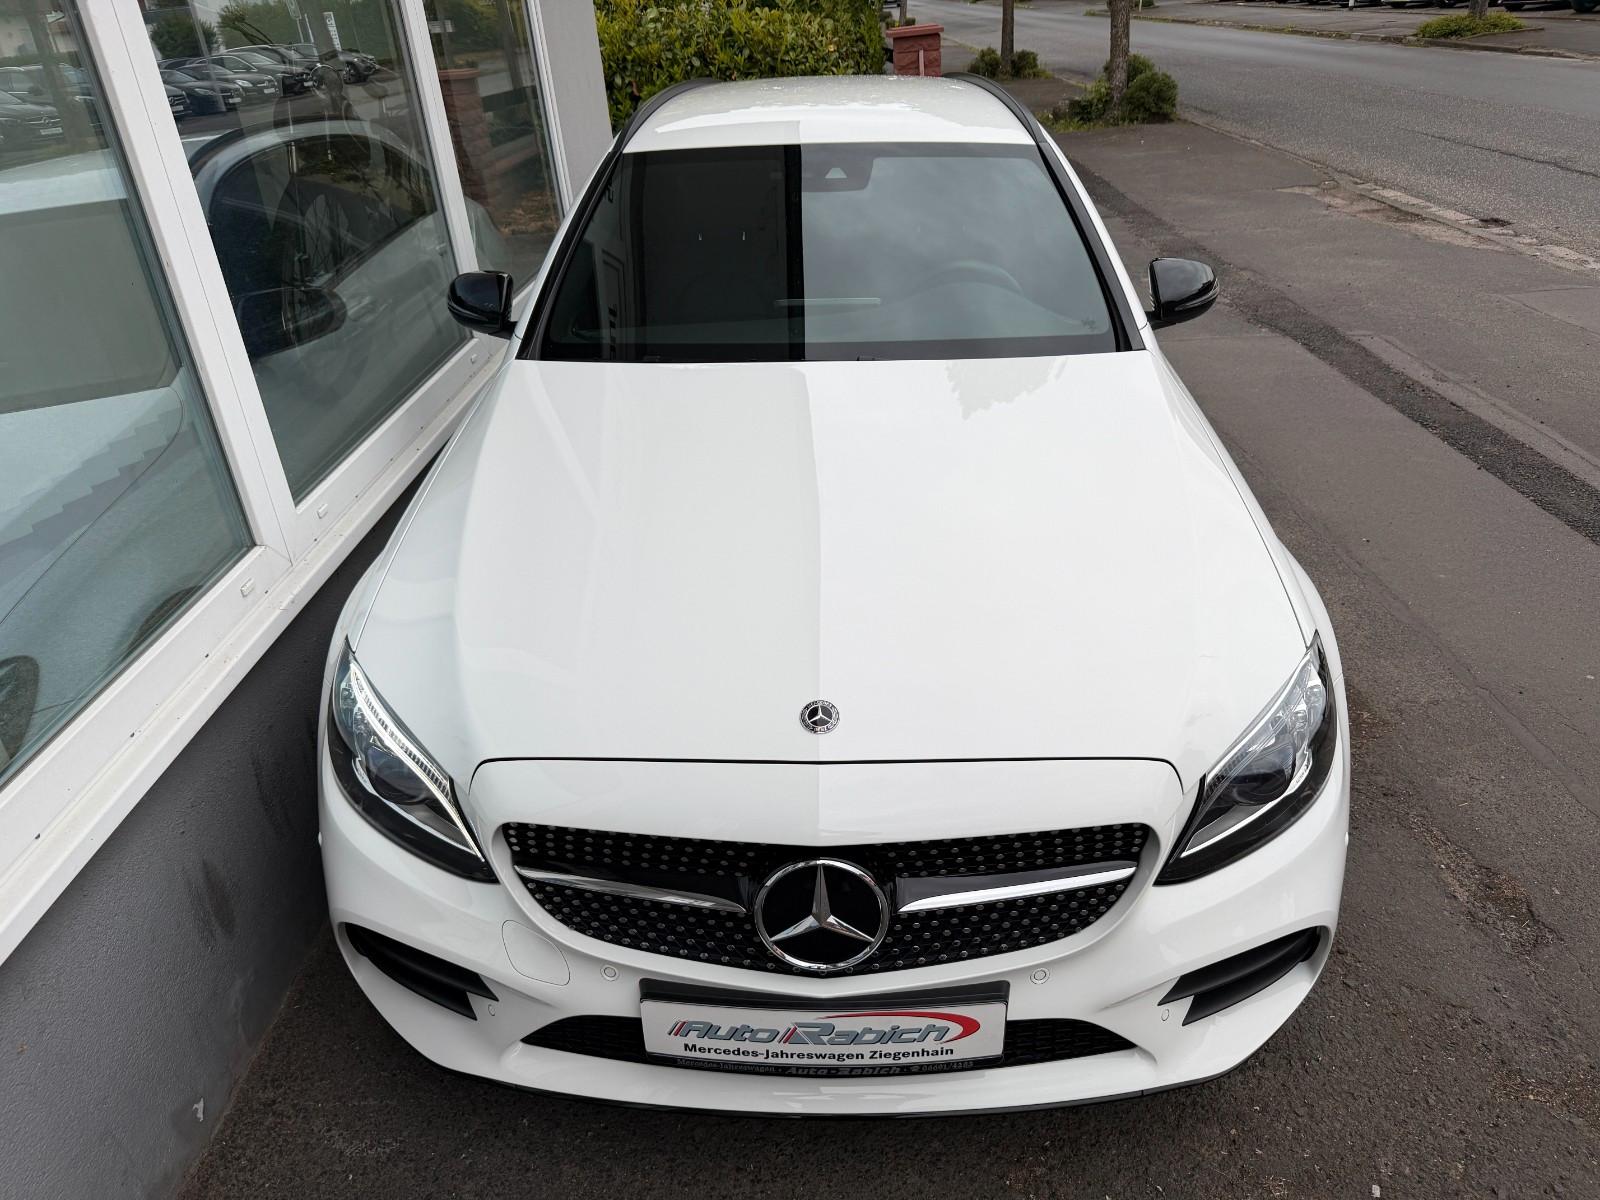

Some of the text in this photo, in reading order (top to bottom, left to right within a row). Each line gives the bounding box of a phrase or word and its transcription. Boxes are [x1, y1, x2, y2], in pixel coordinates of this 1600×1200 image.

[678, 1020, 951, 1046] Auto Rabich
[683, 1042, 954, 1062] Mercedes-Jahreswagen Ziegenhain
